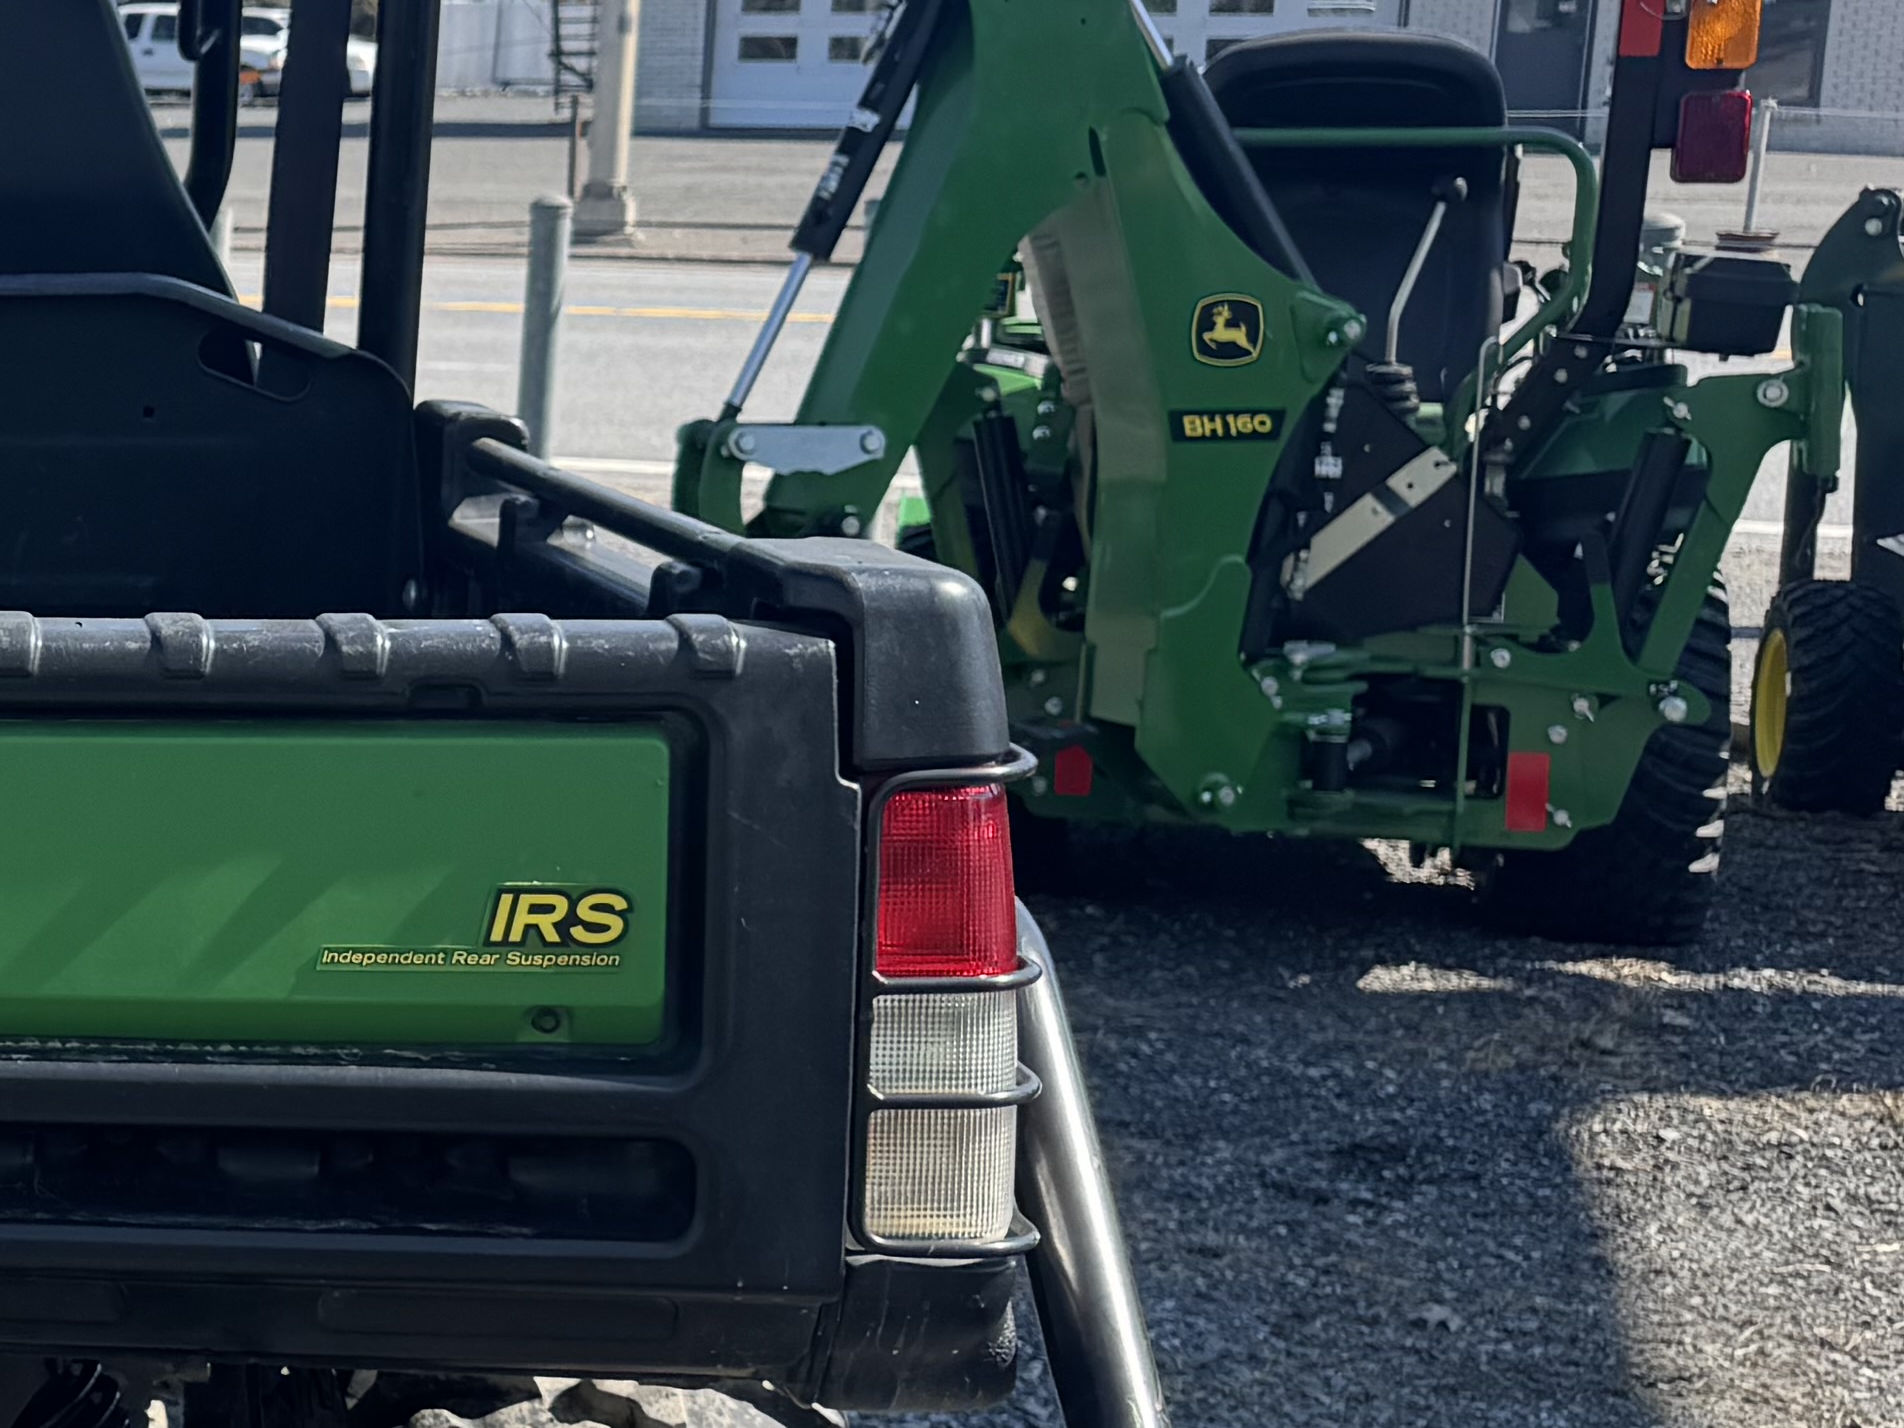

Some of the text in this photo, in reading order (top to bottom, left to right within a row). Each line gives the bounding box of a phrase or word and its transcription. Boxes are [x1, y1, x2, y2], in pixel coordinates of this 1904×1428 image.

[1183, 413, 1272, 437] BH 160
[489, 892, 629, 944] IRS
[321, 949, 621, 968] Independent Rear Suspension
